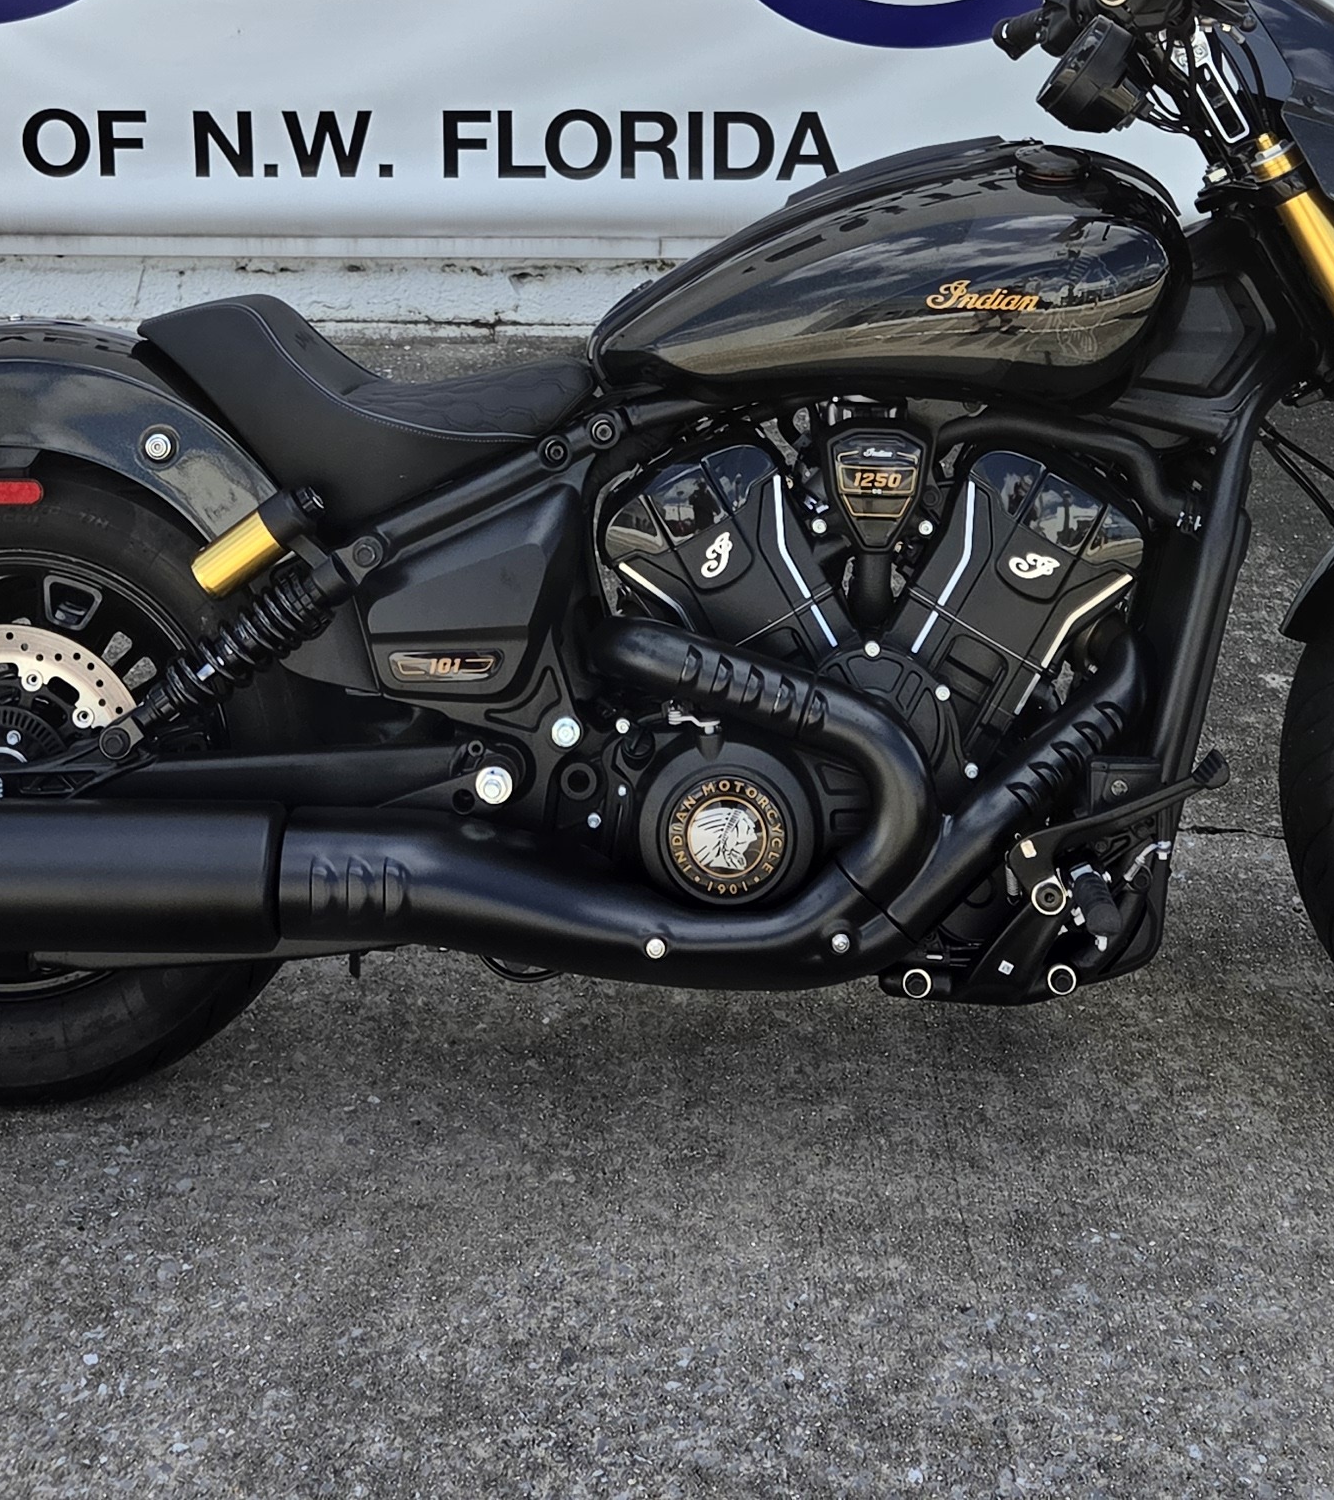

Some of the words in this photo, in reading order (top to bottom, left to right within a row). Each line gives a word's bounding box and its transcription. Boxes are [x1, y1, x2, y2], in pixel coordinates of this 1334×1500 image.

[23, 109, 146, 178] OF
[193, 111, 394, 179] N.W.
[443, 109, 839, 181] FLORIDA
[926, 279, 1040, 312] Indian
[853, 471, 902, 488] 1250
[429, 657, 462, 675] 101
[671, 795, 697, 873] INDIAN
[701, 779, 785, 874] MOTORCYCLE
[706, 880, 749, 895] 1901
